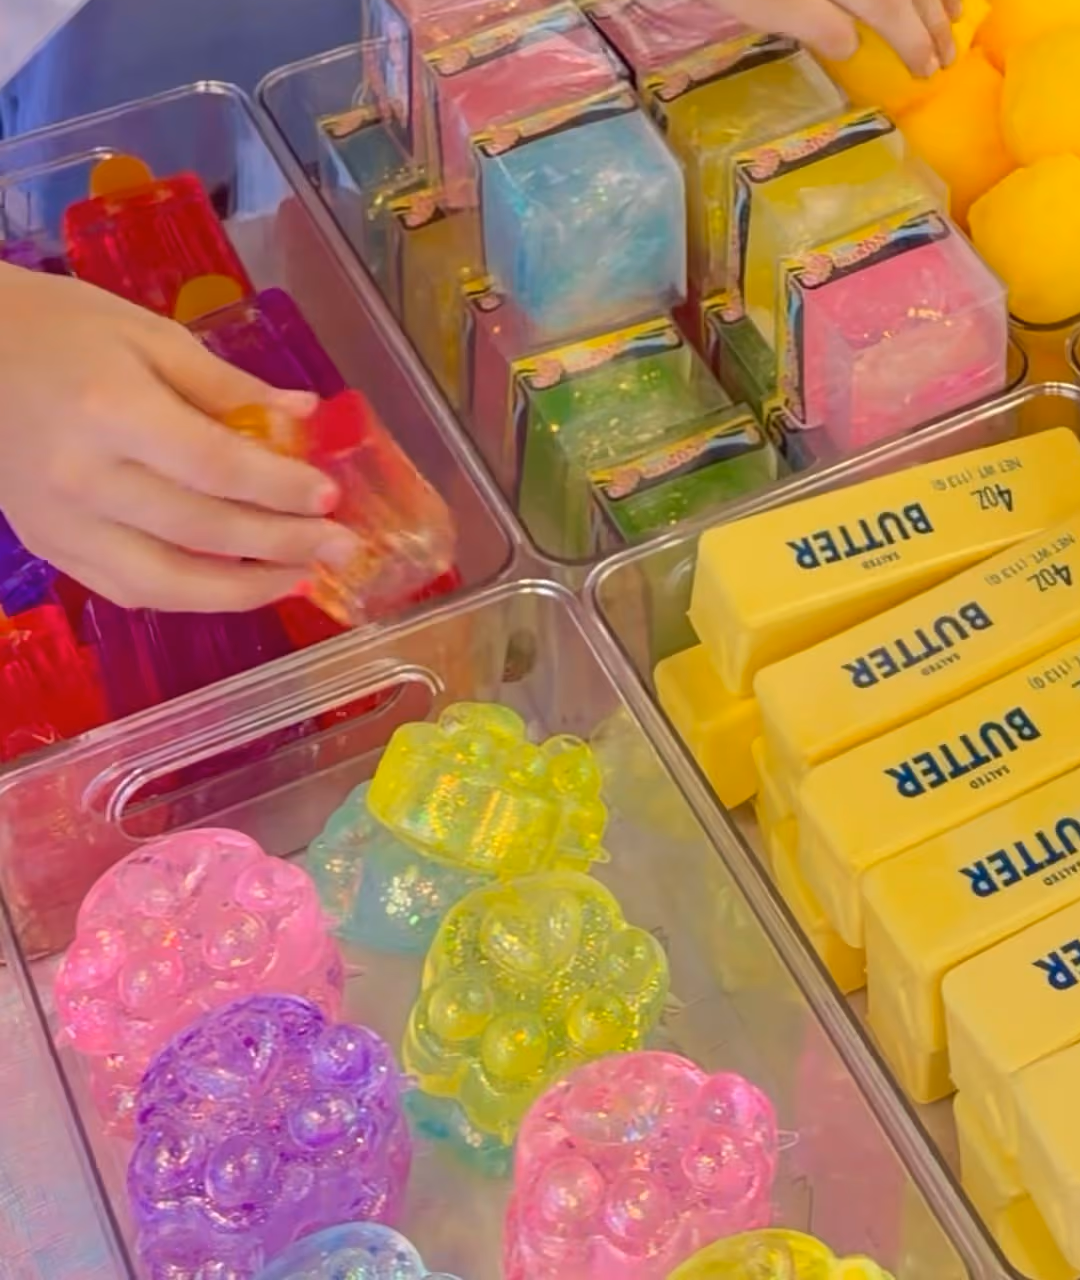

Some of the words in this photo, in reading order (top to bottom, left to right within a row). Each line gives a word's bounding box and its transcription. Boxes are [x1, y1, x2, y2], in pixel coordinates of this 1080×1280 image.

[785, 502, 935, 571] BUTTER
[1050, 533, 1076, 555] NET
[841, 601, 995, 689] BUTTER
[883, 706, 1043, 799] BUTTER
